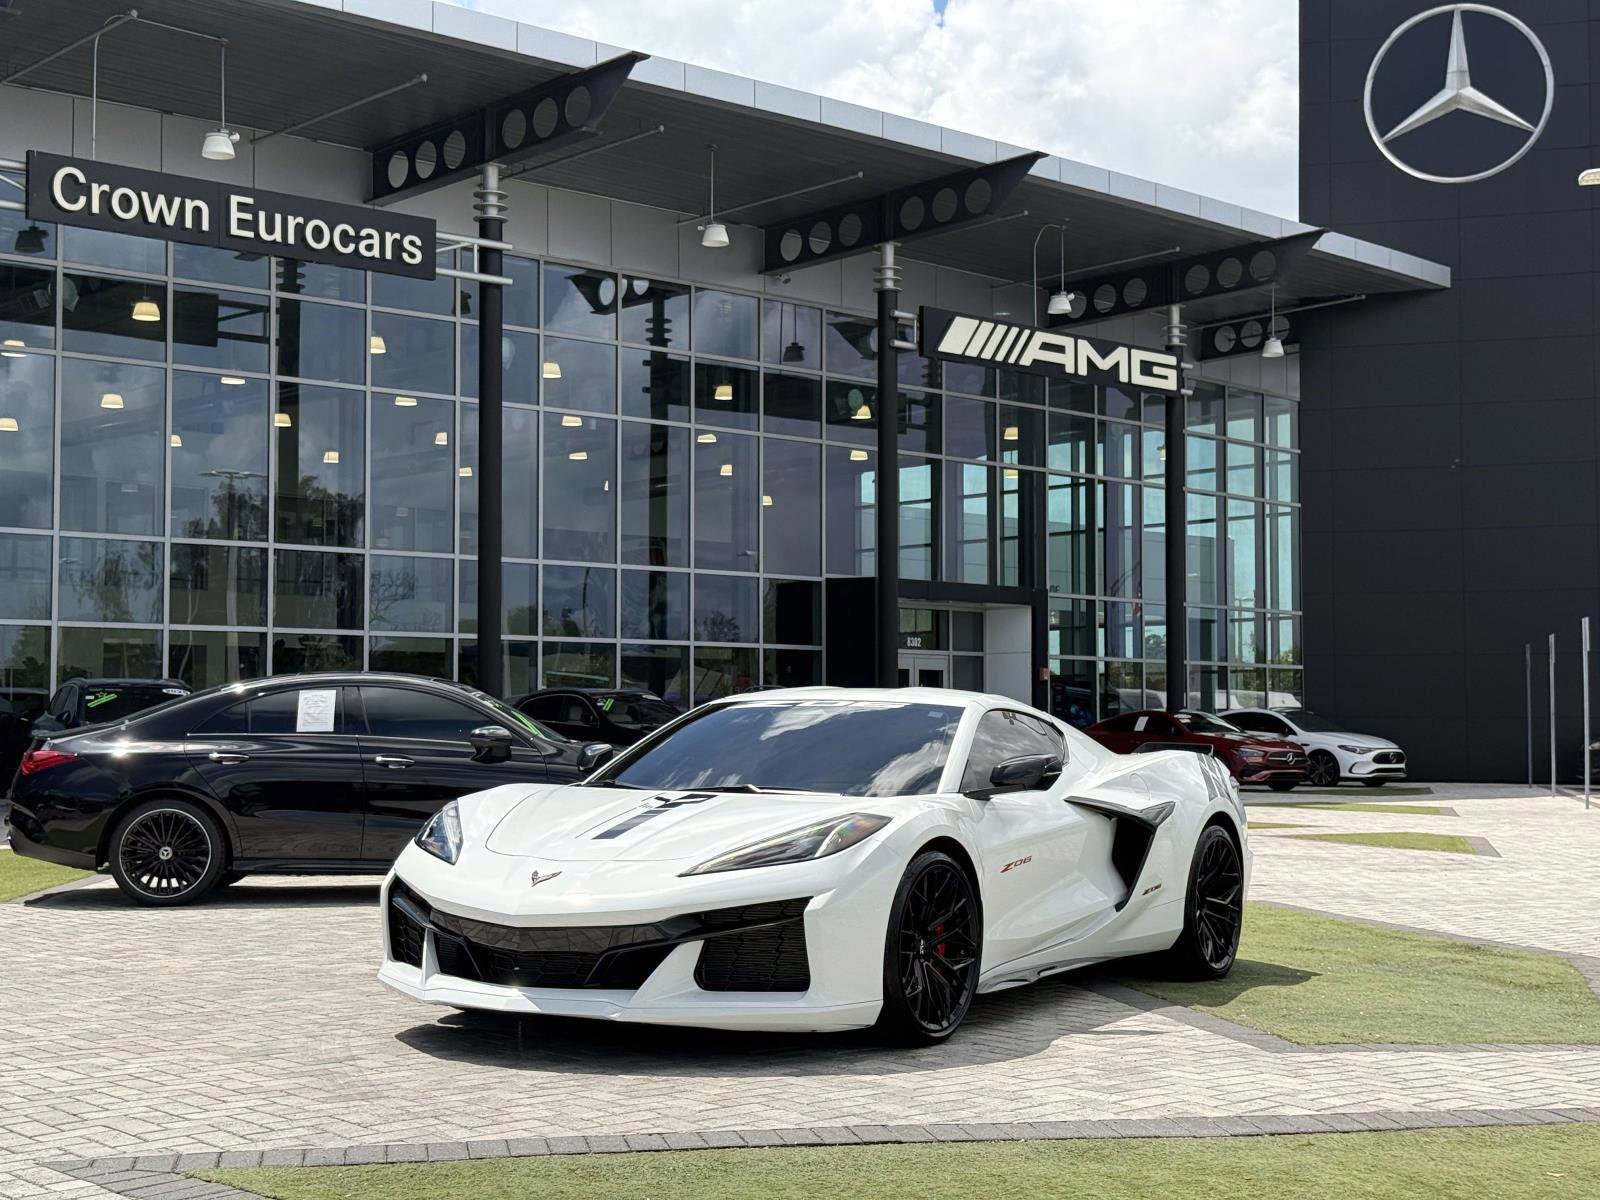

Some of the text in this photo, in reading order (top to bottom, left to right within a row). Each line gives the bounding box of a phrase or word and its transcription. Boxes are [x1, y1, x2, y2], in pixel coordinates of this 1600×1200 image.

[52, 166, 424, 265] Crown Eurocars
[906, 636, 922, 648] 8302
[1000, 855, 1033, 873] Z06
